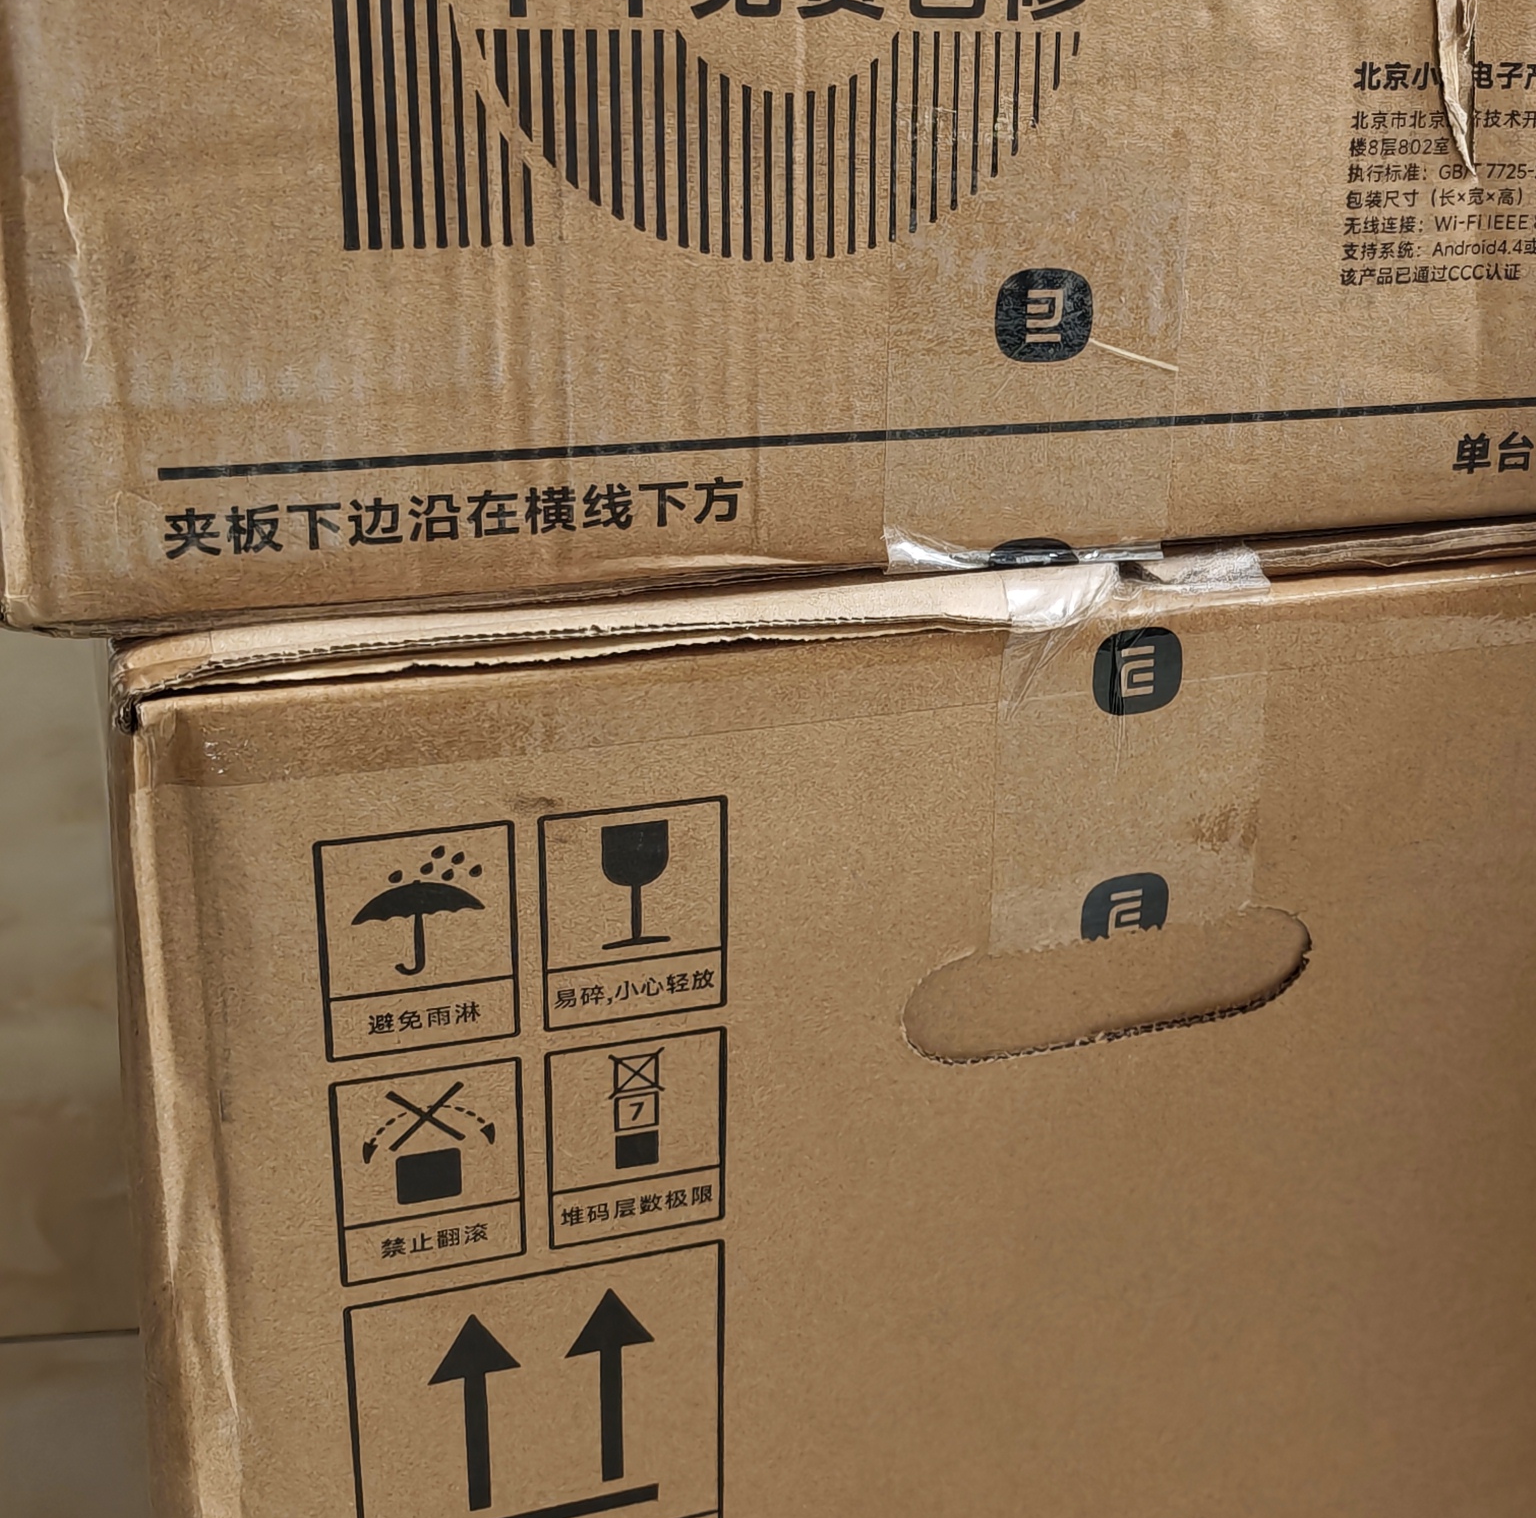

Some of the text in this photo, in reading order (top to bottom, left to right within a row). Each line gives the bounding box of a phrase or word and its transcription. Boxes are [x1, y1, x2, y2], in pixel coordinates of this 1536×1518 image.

[1348, 136, 1451, 159] 楼8层802室
[1434, 212, 1484, 232] Wi-Fi
[1486, 211, 1529, 232] IEEE
[1339, 262, 1521, 287] 该产品已通过CCC认证
[163, 474, 745, 561] 夹板下边沿在横线下方
[367, 1000, 482, 1036] 避免雨淋
[629, 1102, 645, 1122] 7
[560, 1183, 714, 1228] 堆码层数极限
[380, 1221, 489, 1260] 禁止翻滚
